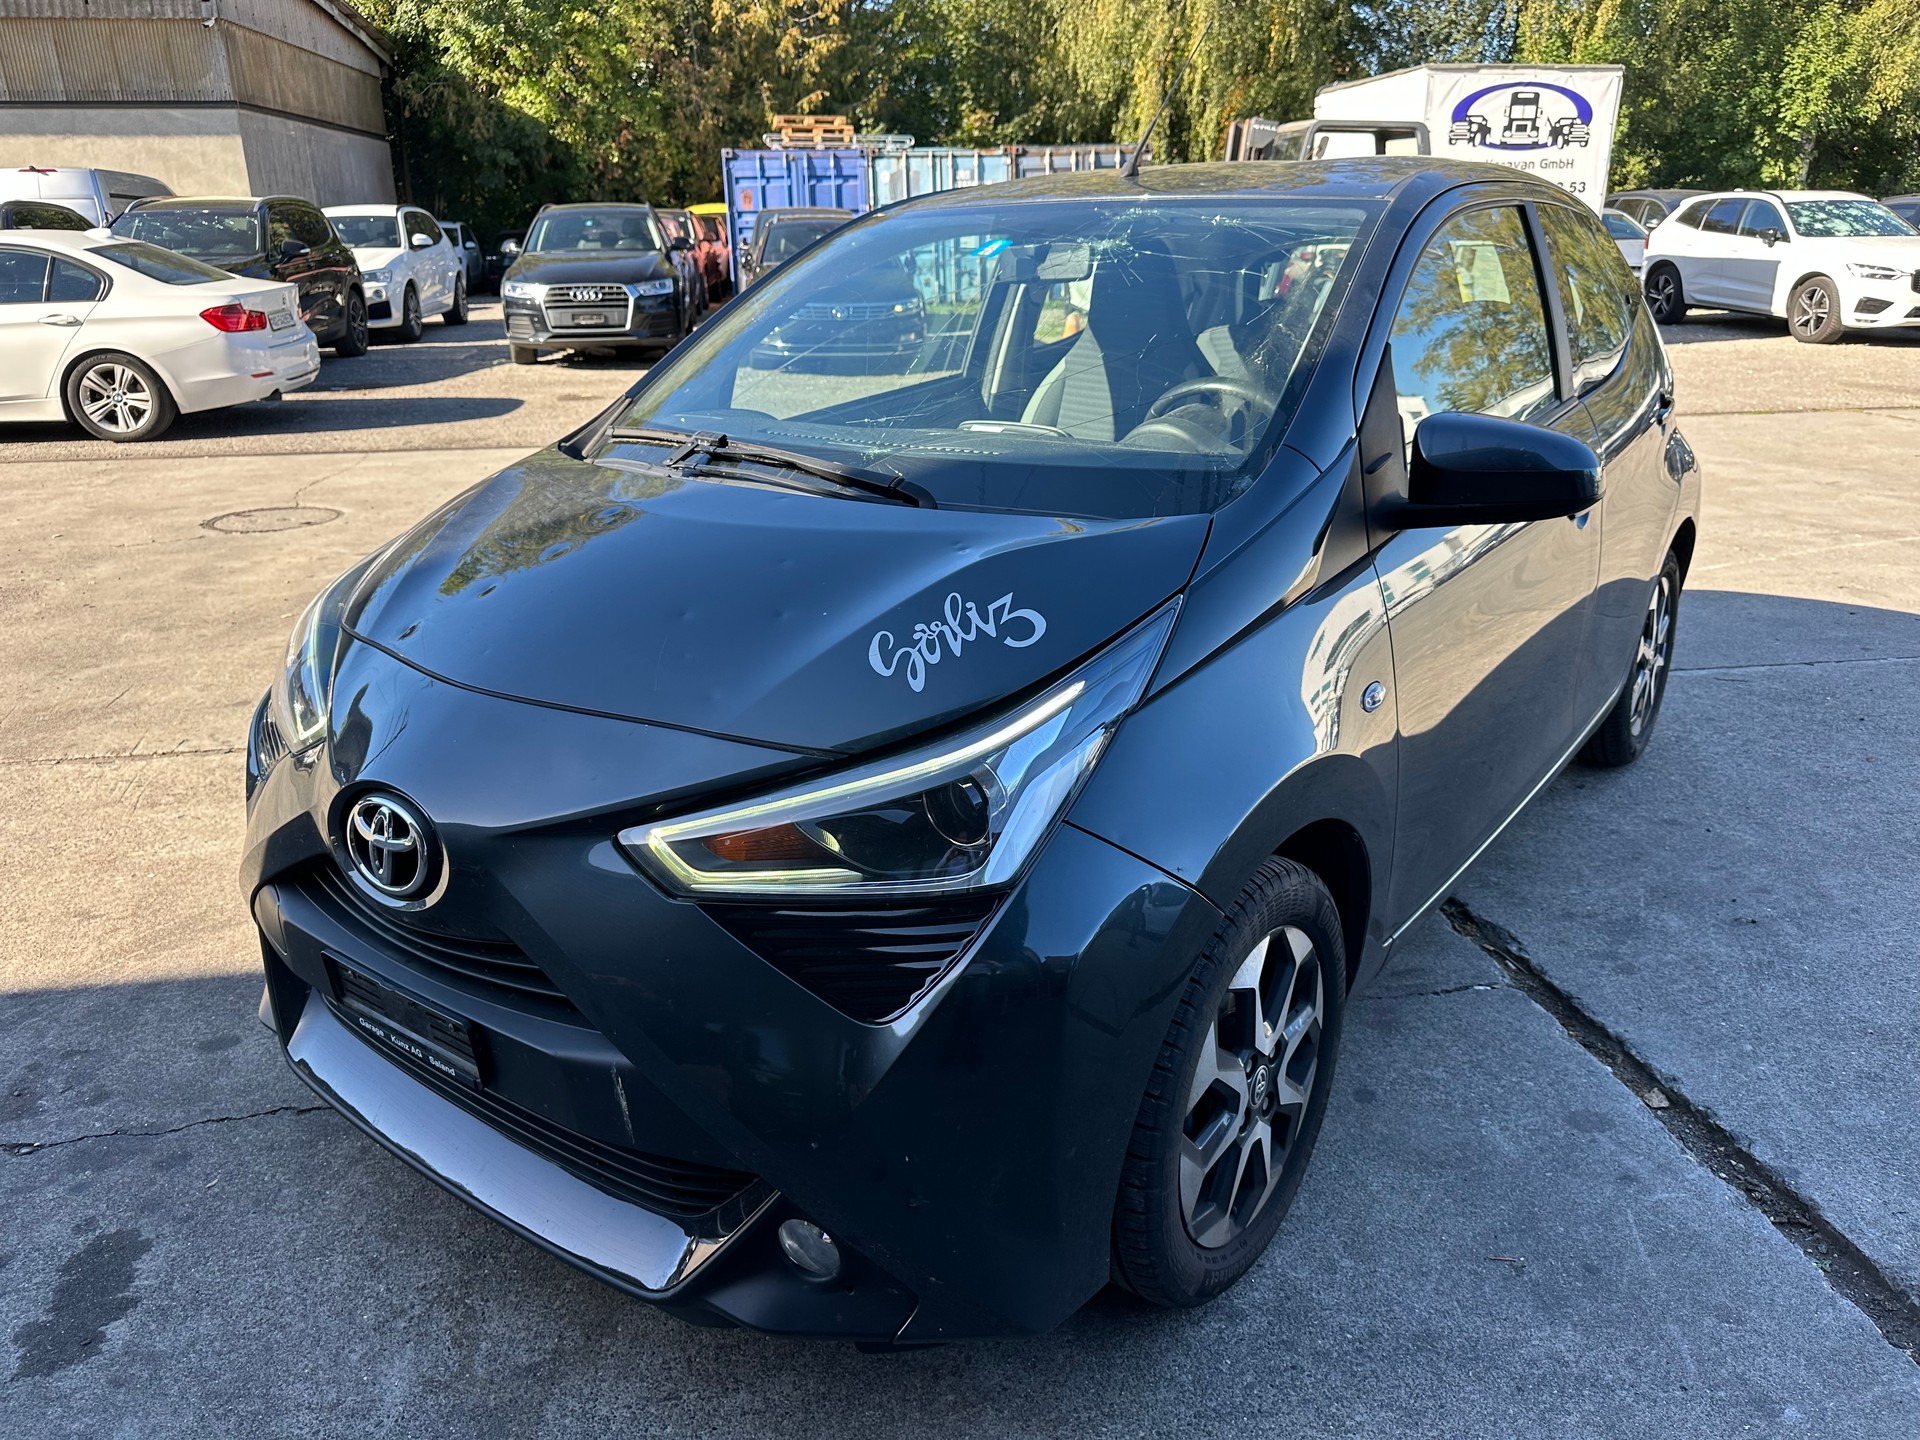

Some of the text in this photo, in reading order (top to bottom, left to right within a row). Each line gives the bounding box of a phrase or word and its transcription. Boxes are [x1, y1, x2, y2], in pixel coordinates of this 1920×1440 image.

[1540, 158, 1574, 169] GmbH
[359, 1017, 456, 1076] Garage Kunz AG Saland
